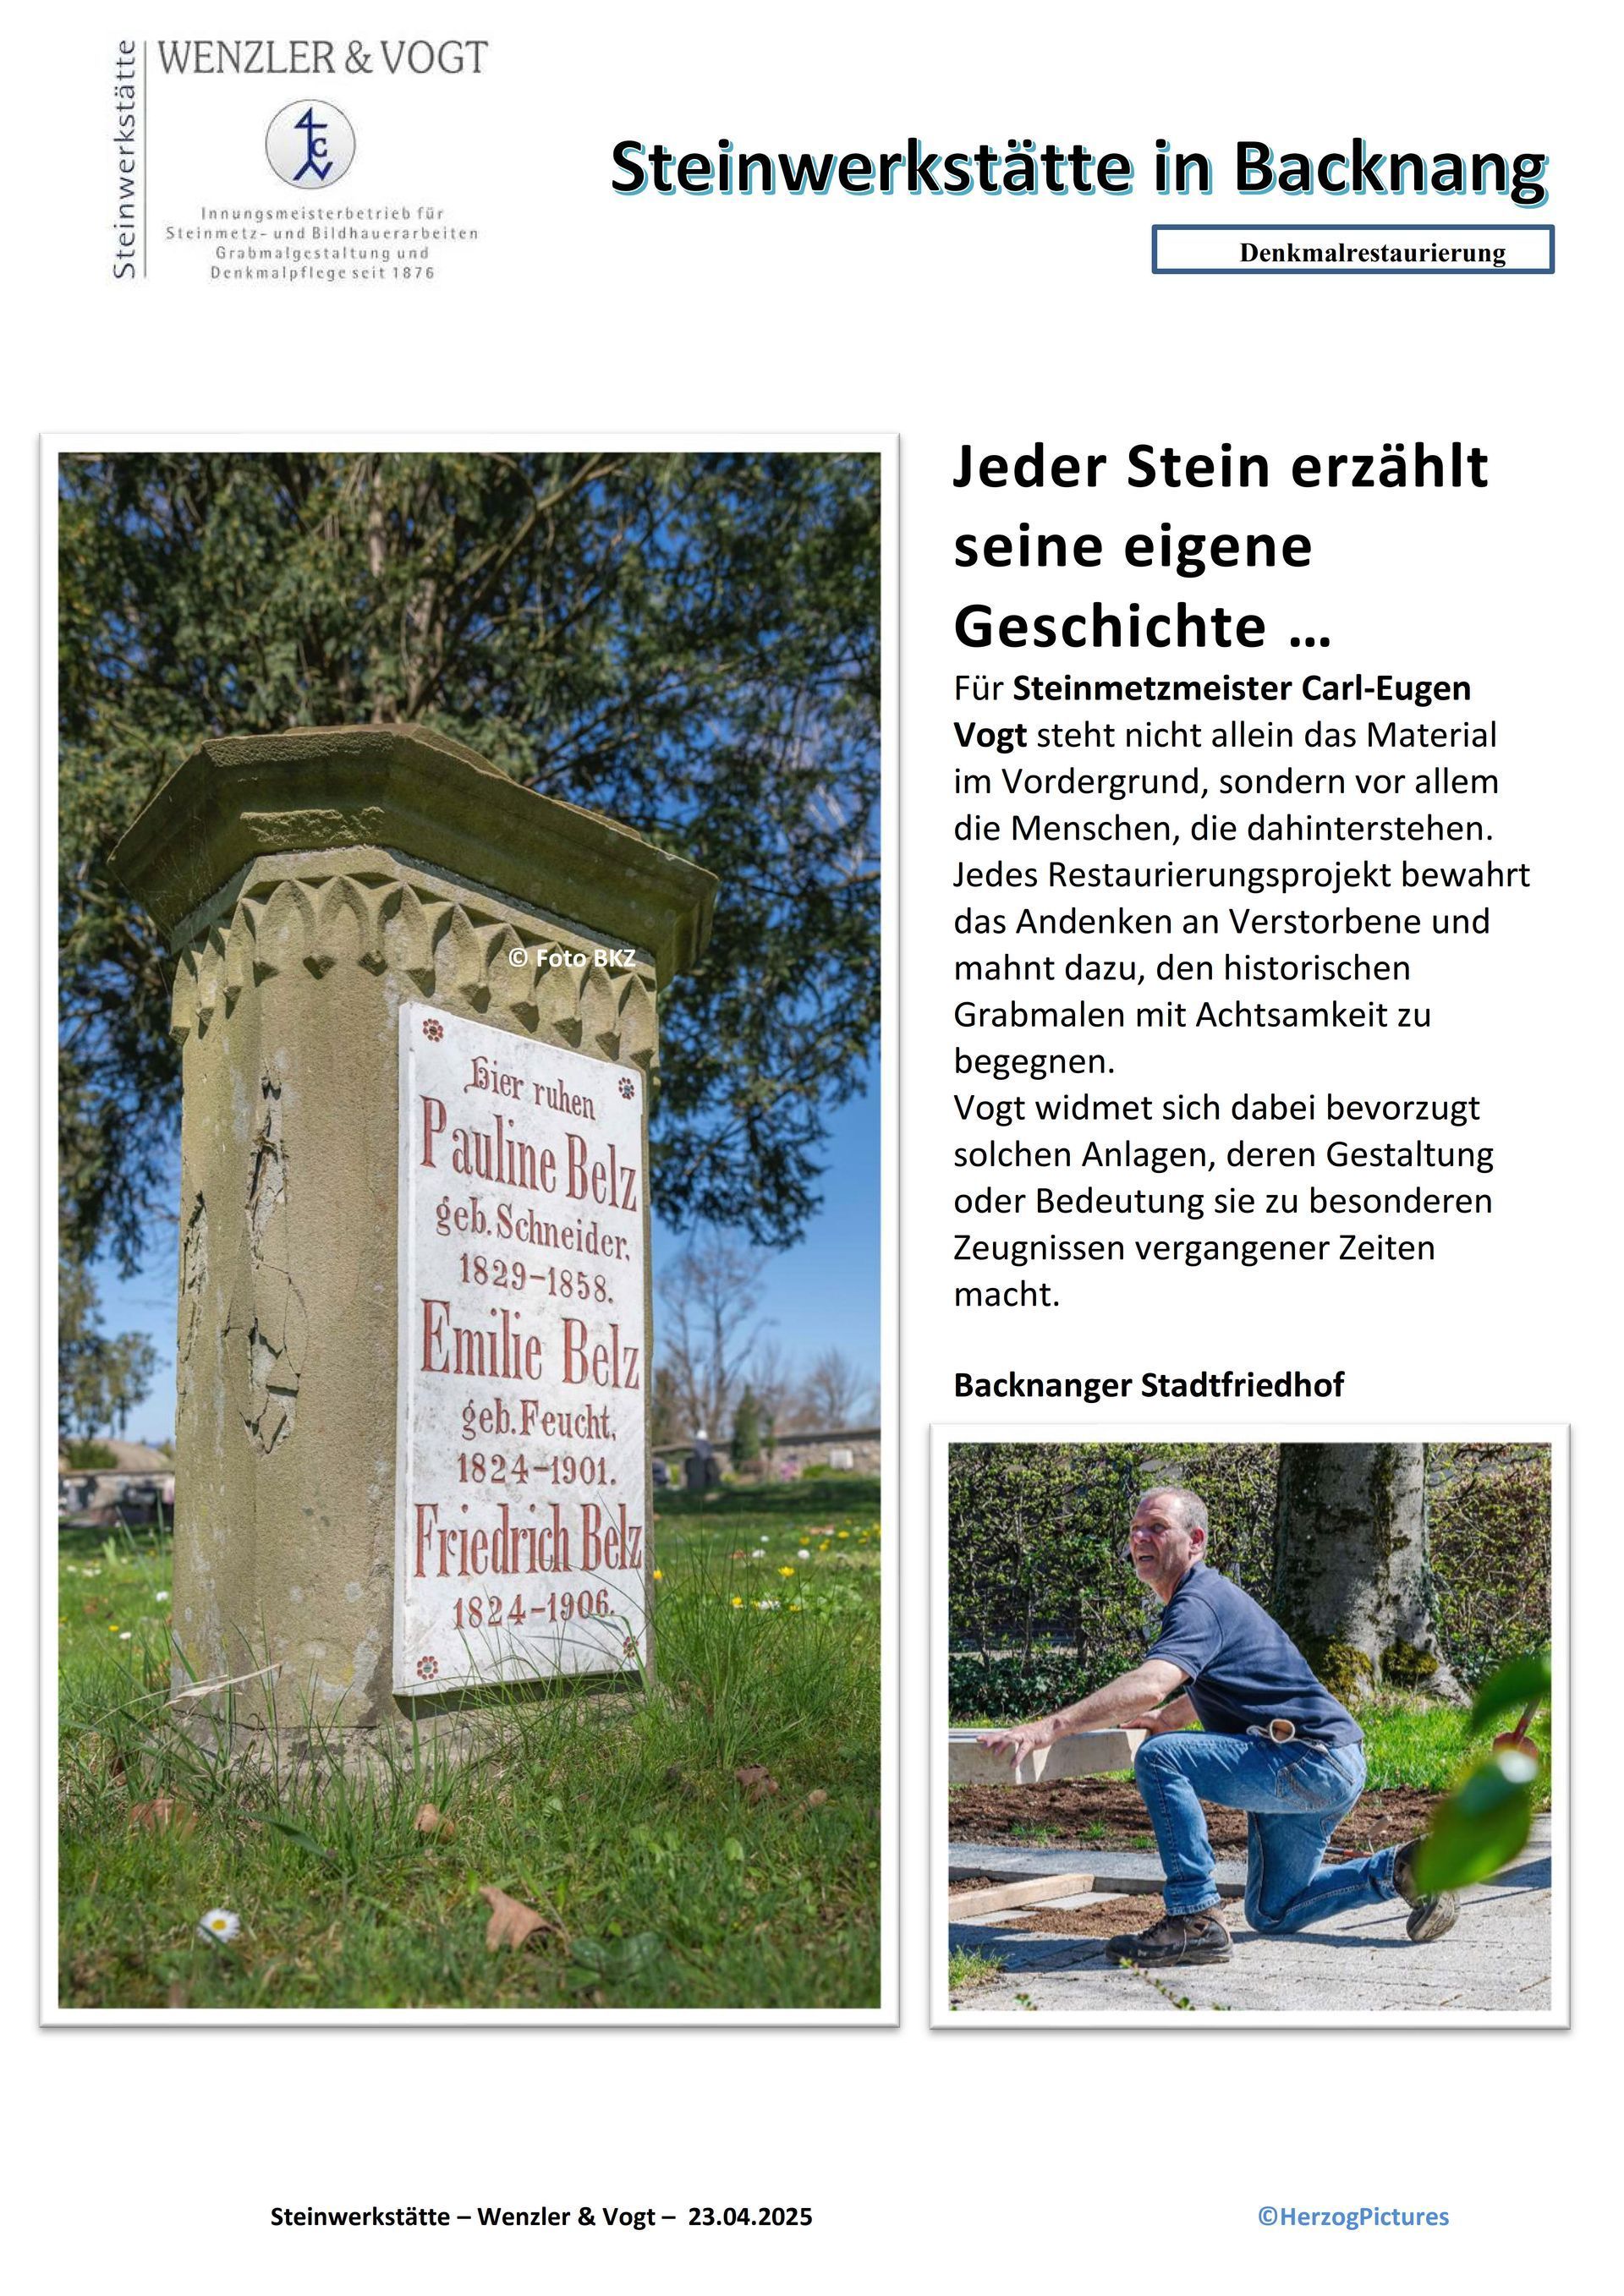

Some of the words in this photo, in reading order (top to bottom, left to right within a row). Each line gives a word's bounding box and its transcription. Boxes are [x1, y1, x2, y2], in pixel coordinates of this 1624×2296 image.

[157, 40, 337, 74] WENZLER
[344, 40, 374, 74] &
[380, 40, 489, 74] VOGT
[112, 39, 137, 280] Steinwerkstätte
[612, 137, 1133, 196] Steinwerkstätte
[1155, 138, 1211, 196] in
[1237, 137, 1550, 210] Backnang
[201, 206, 411, 223] Innungsmeisterbetrieb
[417, 206, 444, 221] für
[167, 226, 268, 240] Steinmetz-
[274, 227, 305, 240] und
[312, 226, 479, 240] Bildhauerarbeiten
[216, 246, 391, 263] Grabmalgestaltung
[397, 247, 430, 260] und
[1238, 242, 1506, 268] Denkmalrestaurierung
[211, 266, 346, 282] Denkmalpflege
[351, 266, 386, 279] seit
[392, 266, 435, 279] 1876
[952, 441, 1107, 488] Jeder
[1127, 442, 1269, 488] Stein
[1292, 441, 1489, 488] erzählt
[955, 522, 1103, 567] seine
[1124, 522, 1312, 578] eigene
[955, 601, 1265, 648] Geschichte
[956, 674, 1005, 701] Für
[1013, 674, 1293, 701] Steinmetzmeister
[1302, 673, 1471, 708] Carl-Eugen
[953, 721, 1028, 754] Vogt
[1037, 720, 1116, 748] steht
[1126, 720, 1202, 748] nicht
[1211, 720, 1293, 748] allein
[1304, 720, 1357, 748] das
[1368, 720, 1496, 748] Material
[955, 768, 990, 794] im
[1001, 766, 1208, 801] Vordergrund,
[1220, 766, 1345, 794] sondern
[1355, 775, 1406, 794] vor
[1415, 766, 1498, 794] allem
[954, 814, 1001, 841] die
[1012, 814, 1180, 846] Menschen,
[1191, 814, 1237, 841] die
[1248, 814, 1492, 841] dahinterstehen.
[952, 860, 1038, 888] Jedes
[1050, 860, 1391, 894] Restaurierungsprojekt
[1402, 860, 1531, 888] bewahrt
[954, 907, 1007, 934] das
[1015, 907, 1171, 934] Andenken
[1182, 914, 1219, 934] an
[1228, 907, 1421, 934] Verstorbene
[1433, 907, 1490, 934] und
[955, 953, 1055, 981] mahnt
[1065, 953, 1144, 986] dazu,
[1156, 953, 1213, 981] den
[1225, 953, 1410, 981] historischen
[954, 1000, 1124, 1027] Grabmalen
[1137, 1001, 1187, 1027] mit
[1195, 1000, 1388, 1027] Achtsamkeit
[1397, 1008, 1430, 1027] zu
[955, 1046, 1114, 1081] begegnen.
[464, 1056, 525, 1100] Hier
[532, 1078, 596, 1121] ruhen
[953, 1094, 1026, 1127] Vogt
[1034, 1093, 1153, 1121] widmet
[1162, 1093, 1220, 1121] sich
[1232, 1093, 1315, 1121] dabei
[1327, 1093, 1480, 1127] bevorzugt
[420, 1094, 557, 1193] Pauline
[565, 1132, 638, 1213] Belz
[954, 1139, 1071, 1167] solchen
[1081, 1139, 1215, 1174] Anlagen,
[1226, 1139, 1315, 1167] deren
[1326, 1139, 1494, 1174] Gestaltung
[954, 1186, 1026, 1214] oder
[1037, 1186, 1204, 1220] Bedeutung
[1214, 1187, 1255, 1214] sie
[1265, 1194, 1298, 1214] zu
[1310, 1186, 1492, 1214] besonderen
[953, 1234, 1124, 1267] Zeugnissen
[1134, 1241, 1330, 1267] vergangener
[1339, 1234, 1435, 1261] Zeiten
[955, 1280, 1059, 1307] macht.
[420, 1299, 542, 1381] Emilie
[562, 1318, 639, 1389] Belz
[955, 1371, 1133, 1404] Backnanger
[1141, 1370, 1346, 1398] Stadtfriedhof
[414, 1503, 570, 1579] Friedrich
[580, 1503, 643, 1571] Belz
[271, 2206, 451, 2227] Steinwerkstätte
[477, 2206, 571, 2227] Wenzler
[577, 2206, 596, 2227] &
[601, 2207, 656, 2231] Vogt
[689, 2206, 813, 2227] 23.04.2025
